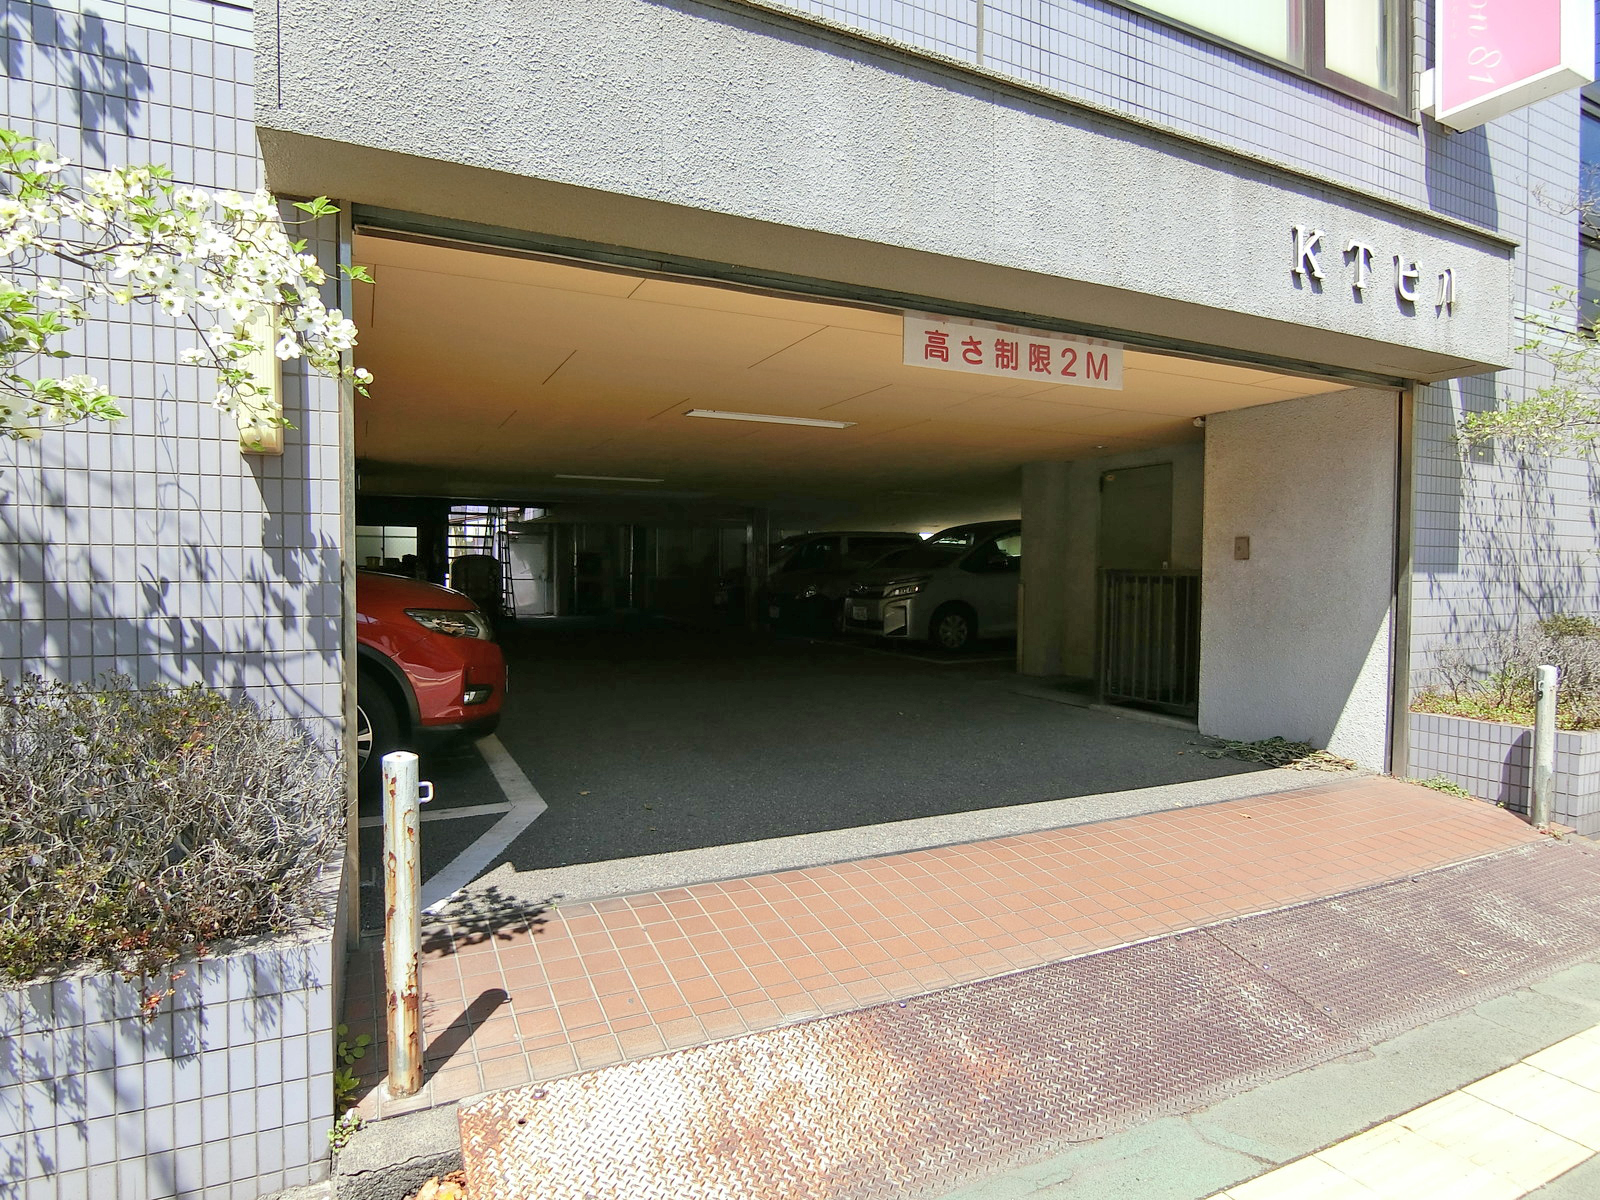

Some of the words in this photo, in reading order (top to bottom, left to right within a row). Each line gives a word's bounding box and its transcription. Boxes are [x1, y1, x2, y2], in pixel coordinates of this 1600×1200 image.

[1467, 46, 1503, 85] 81
[923, 329, 1109, 381] 高さ制限2M
